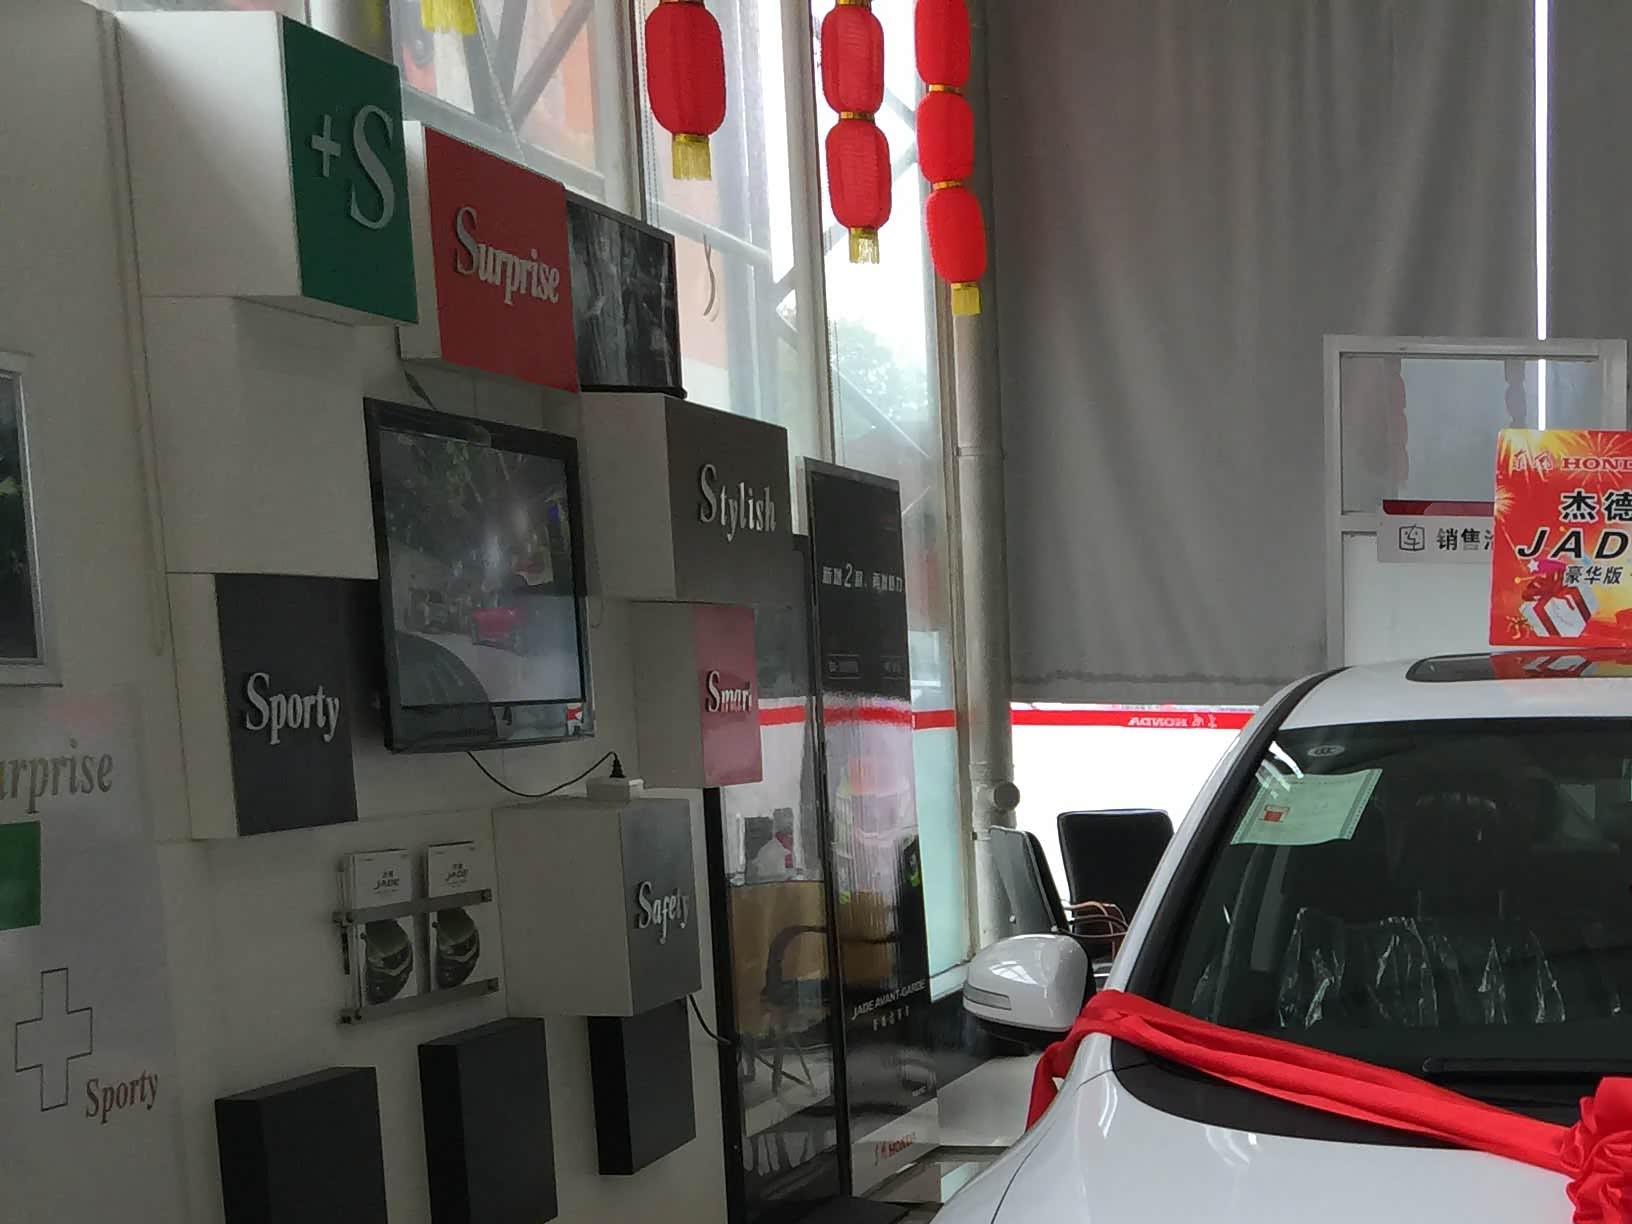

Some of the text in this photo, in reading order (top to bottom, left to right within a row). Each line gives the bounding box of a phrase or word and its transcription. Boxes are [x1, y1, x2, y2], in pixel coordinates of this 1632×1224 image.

[456, 206, 560, 305] Surprise
[700, 463, 776, 542] Stylish
[1564, 565, 1624, 586] 豪华版
[246, 672, 340, 745] Sporty
[708, 670, 752, 712] Smart
[638, 881, 688, 944] Safety
[86, 1069, 158, 1124] Sporty
